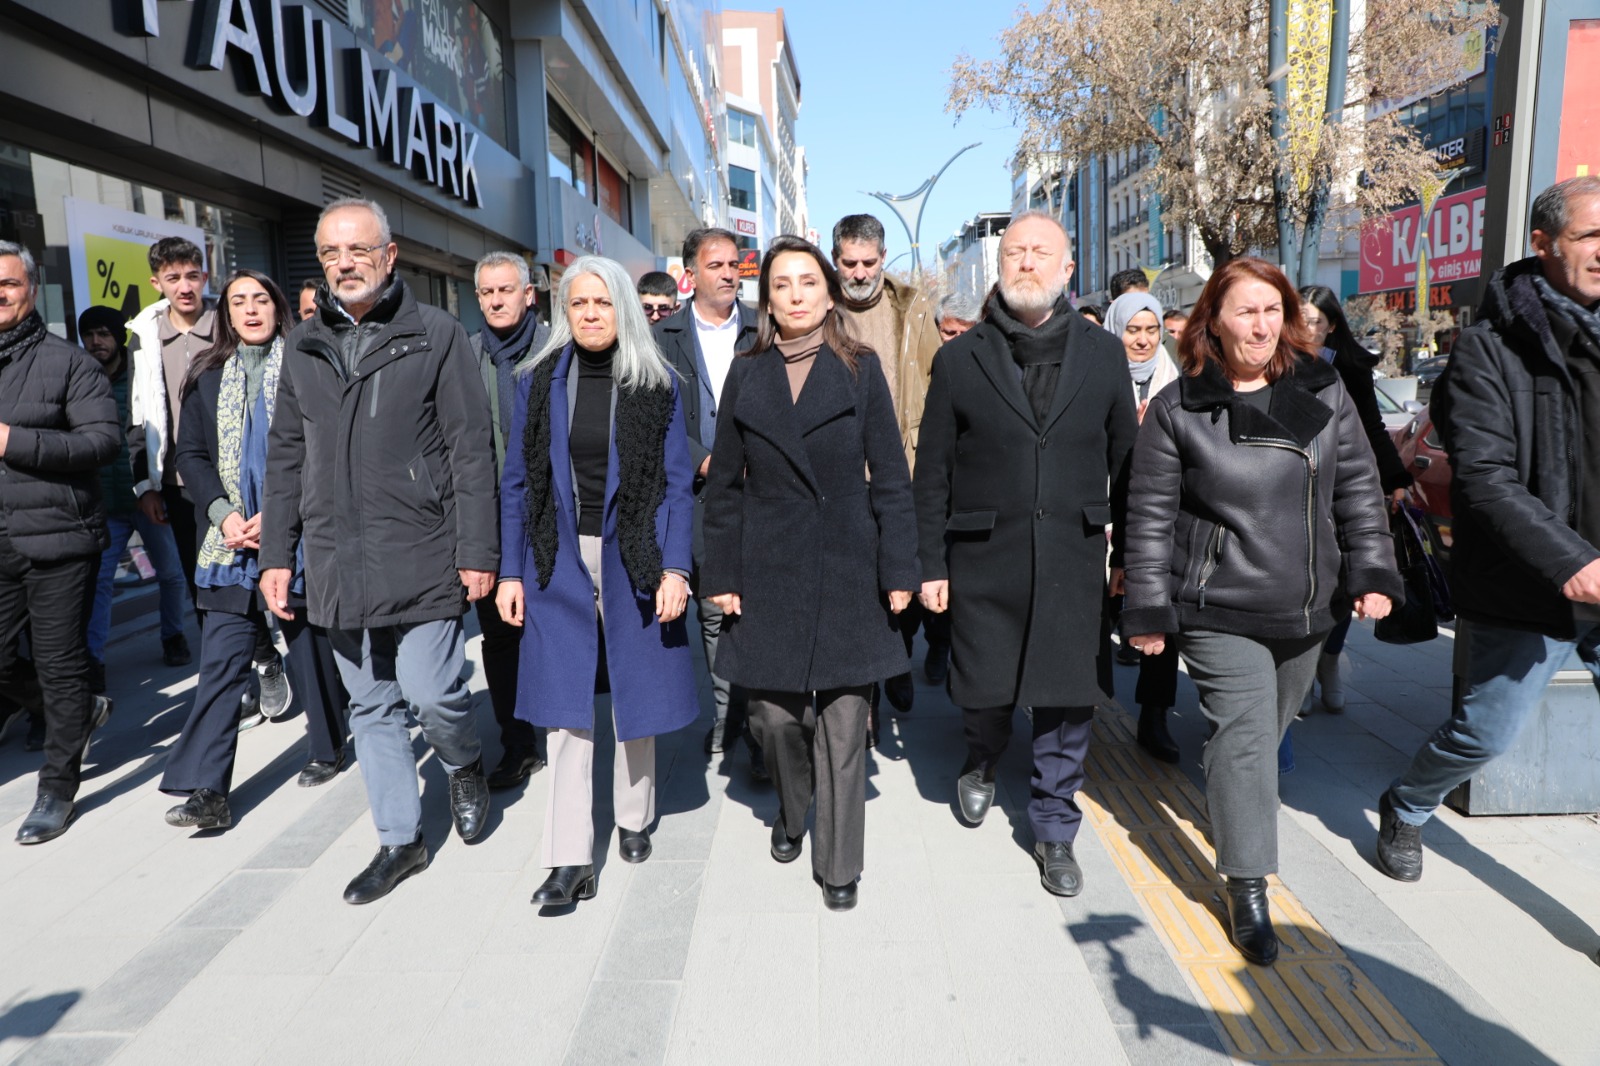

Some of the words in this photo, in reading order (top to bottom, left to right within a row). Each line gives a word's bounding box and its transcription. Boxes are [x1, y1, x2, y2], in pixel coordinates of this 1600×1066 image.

[422, 15, 463, 78] MARK
[141, 0, 483, 208] AULMARK
[1438, 259, 1462, 279] GİRİŞ
[1408, 285, 1453, 309] PRK
